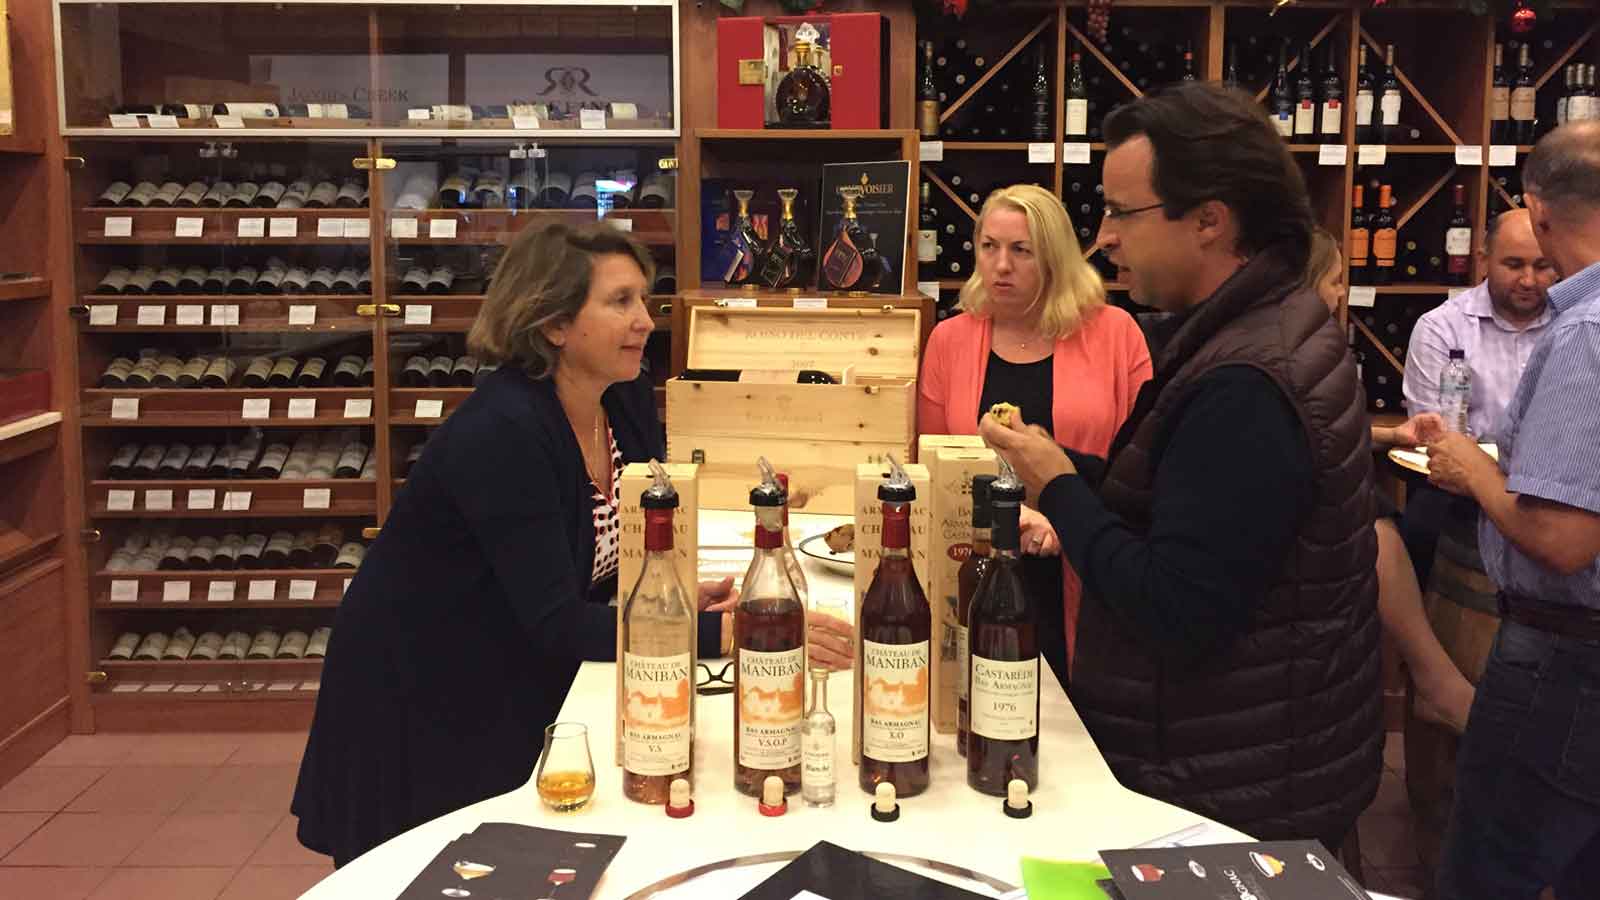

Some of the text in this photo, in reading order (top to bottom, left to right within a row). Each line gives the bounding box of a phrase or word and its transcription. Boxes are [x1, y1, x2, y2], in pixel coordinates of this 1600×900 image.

[742, 661, 801, 677] MANIBAN
[866, 655, 927, 669] MANIBAN
[626, 664, 688, 681] MANIBAN
[993, 702, 1017, 712] 1976
